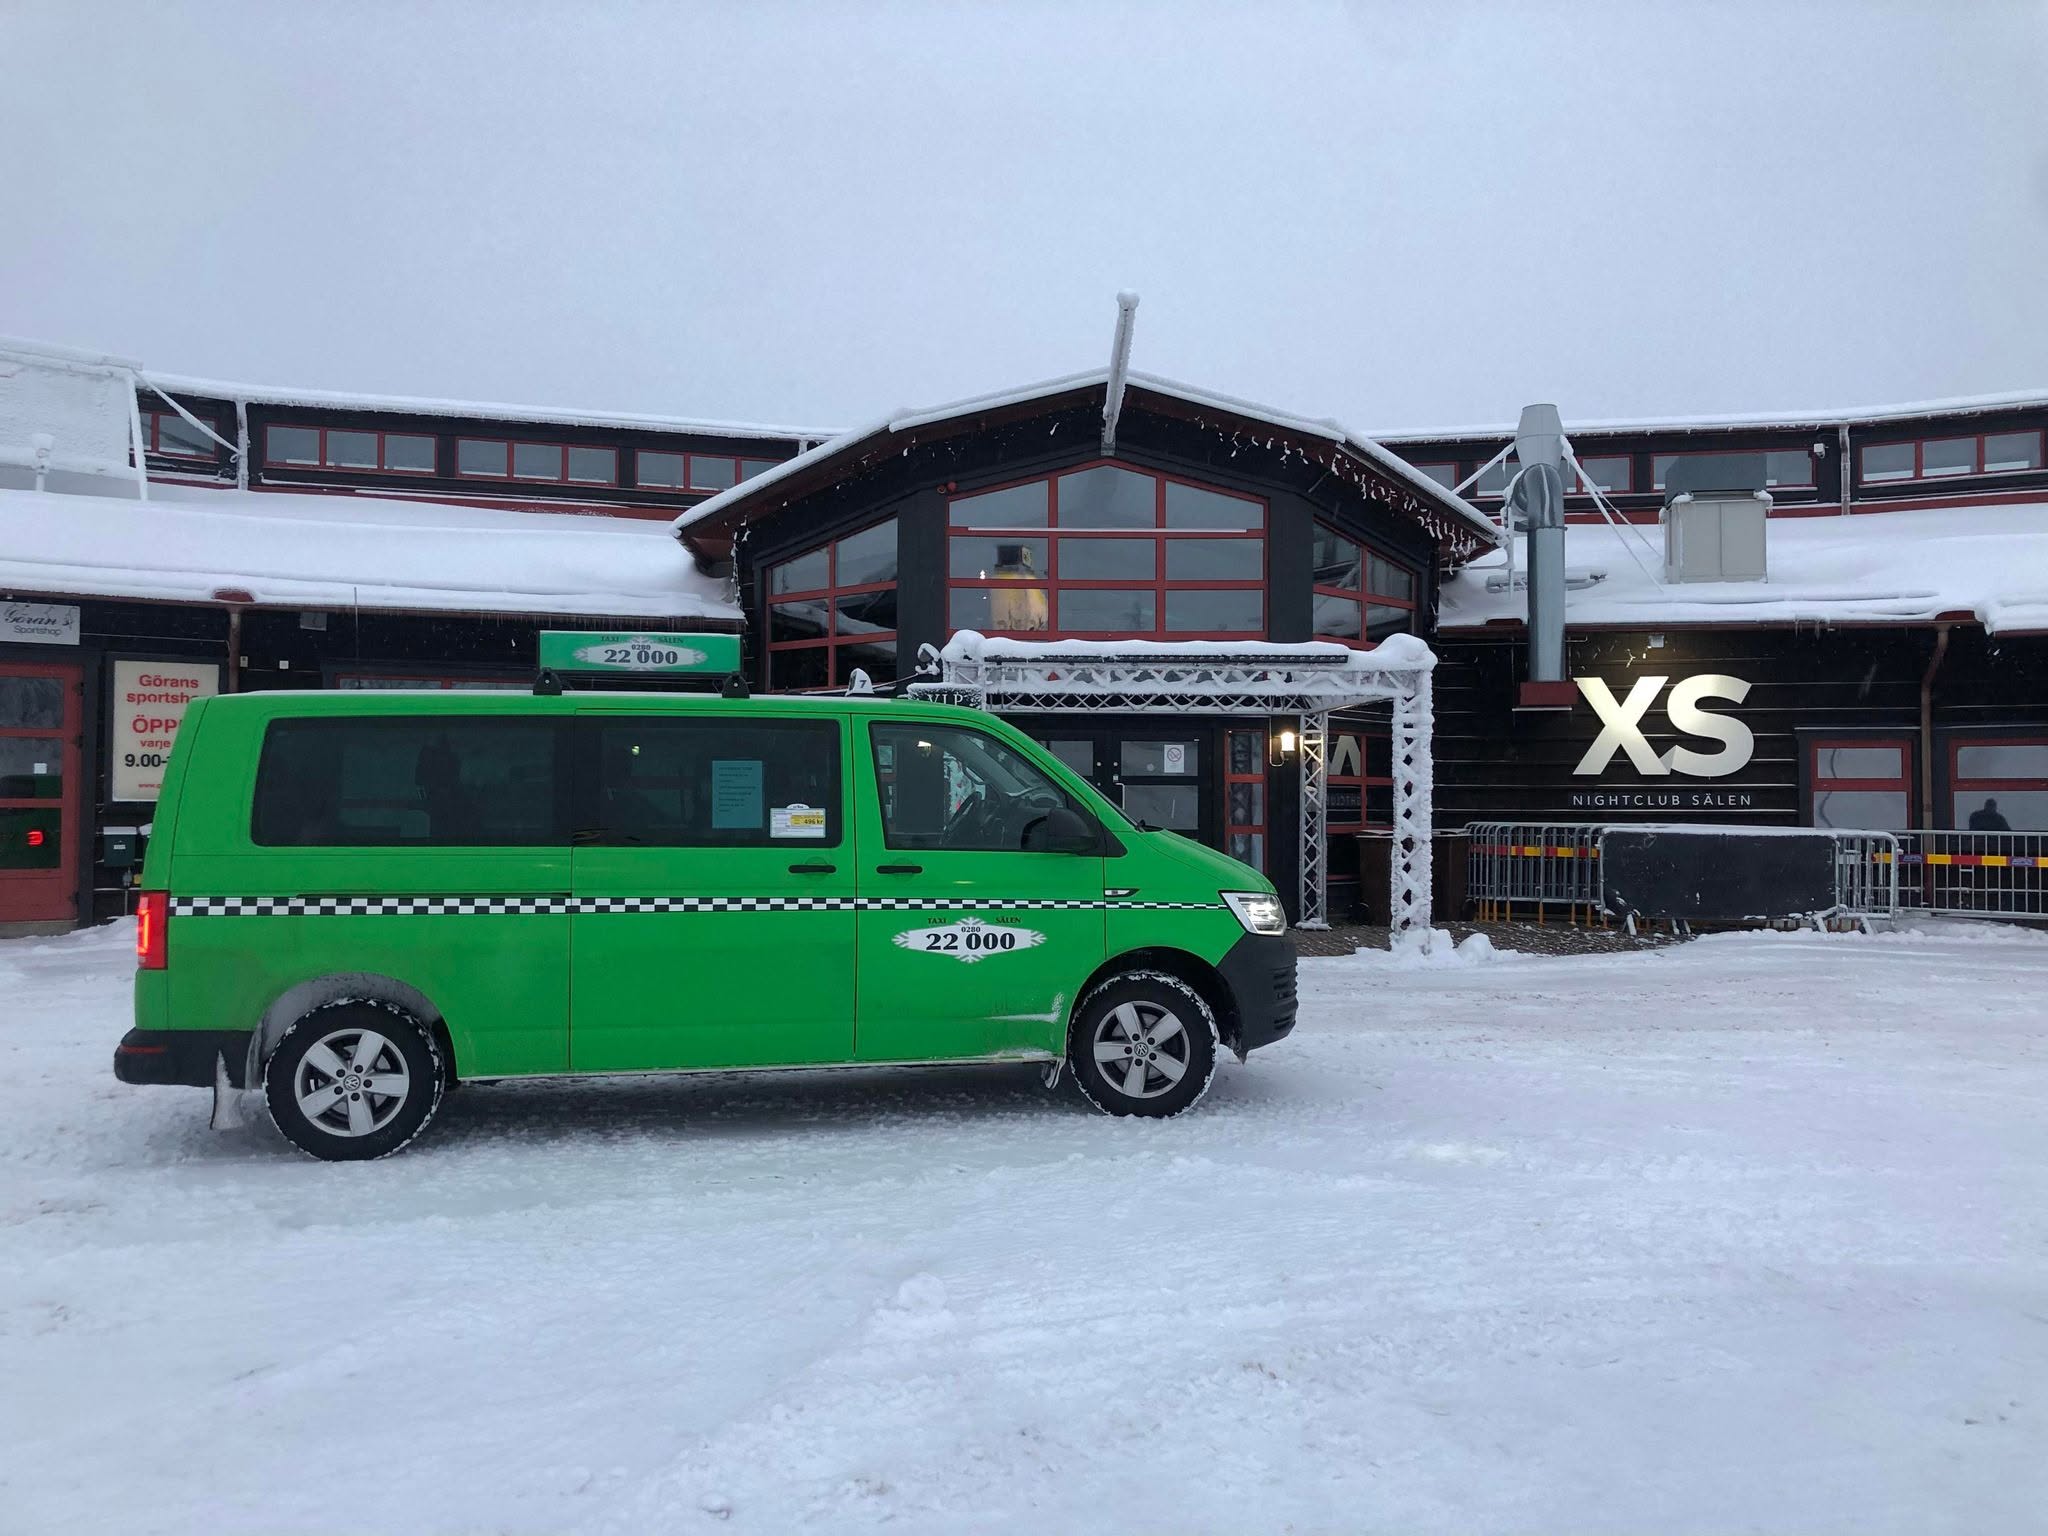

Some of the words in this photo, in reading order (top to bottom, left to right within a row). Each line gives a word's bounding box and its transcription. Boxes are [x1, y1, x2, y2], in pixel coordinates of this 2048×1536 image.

[604, 649, 630, 663] 22
[637, 651, 678, 664] 000
[139, 674, 199, 689] Görans
[859, 680, 867, 688] 7
[127, 692, 199, 705] sportsh
[927, 693, 963, 706] VIP
[132, 714, 183, 733] ÖPP
[1572, 673, 1755, 778] XS
[140, 739, 171, 750] varje
[124, 753, 170, 768] 9.00-
[1572, 795, 1681, 806] NIGHTCLUB
[1692, 793, 1752, 806] SÄLEN
[925, 933, 959, 950] 22
[965, 933, 1016, 950] 000
